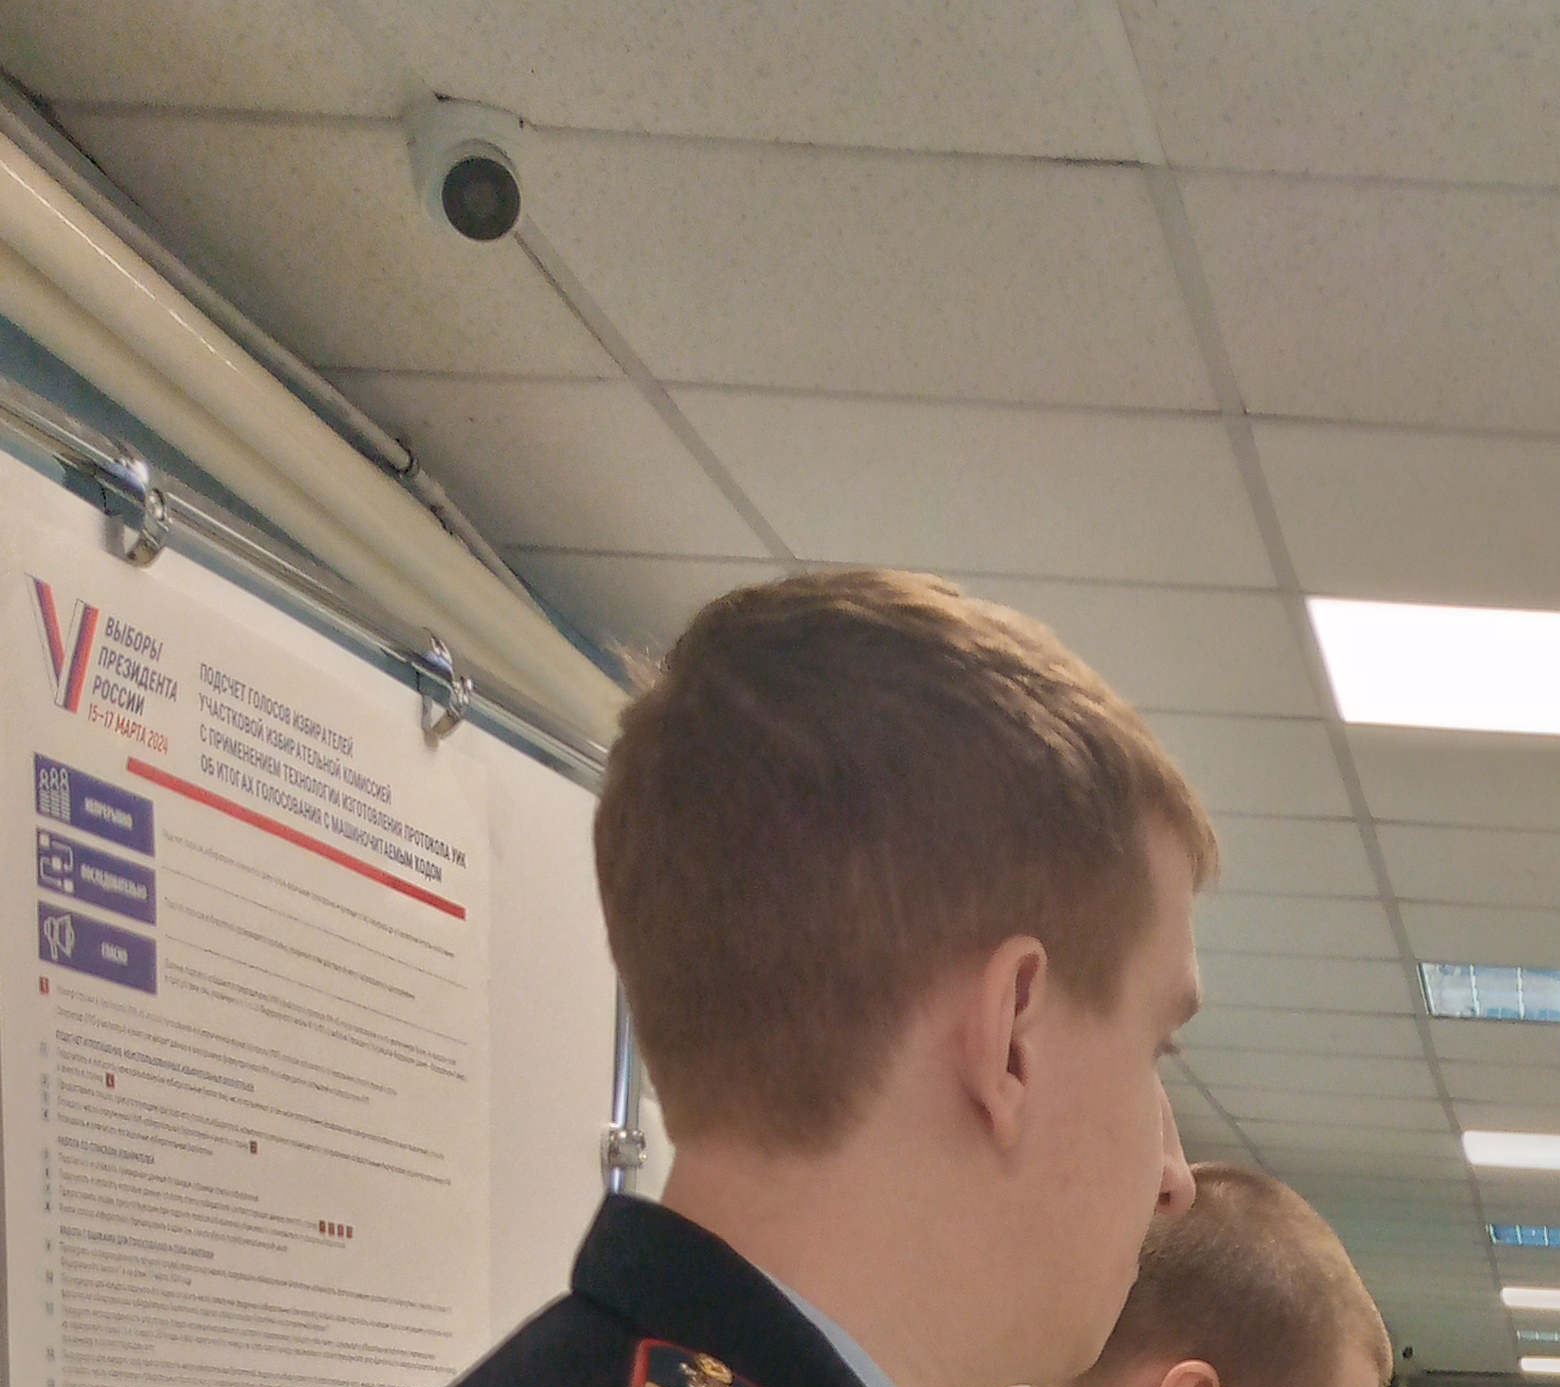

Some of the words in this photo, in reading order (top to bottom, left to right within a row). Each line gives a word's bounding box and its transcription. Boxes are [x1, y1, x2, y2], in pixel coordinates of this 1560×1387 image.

[105, 616, 163, 662] ВЫБОРЫ
[92, 675, 145, 717] РОССИИ
[98, 646, 178, 702] ПРЕЗИДЕНТА
[115, 713, 147, 744] МАРТА
[149, 730, 170, 755] 2024
[200, 662, 246, 702] ПОДСЧЕТ
[248, 688, 292, 725] ГОЛОСОВ
[293, 710, 354, 758] ИЗБИРАТЕЛЕЙ
[199, 692, 265, 742] УЧАСТКОВОЙ
[265, 725, 342, 780] ИЗБИРАТЕЛЬНОЙ
[343, 766, 392, 805] КОМИССИЕЙ
[200, 724, 208, 742] С
[209, 728, 281, 778] ПРИМЕНЕНИЕМ
[283, 762, 341, 808] ТЕХНОЛОГИИ
[200, 753, 215, 776] ОБ
[216, 761, 254, 796] ИТОГАХ
[255, 779, 322, 825] ГОЛОСОВАНИЯ
[323, 810, 330, 830] С
